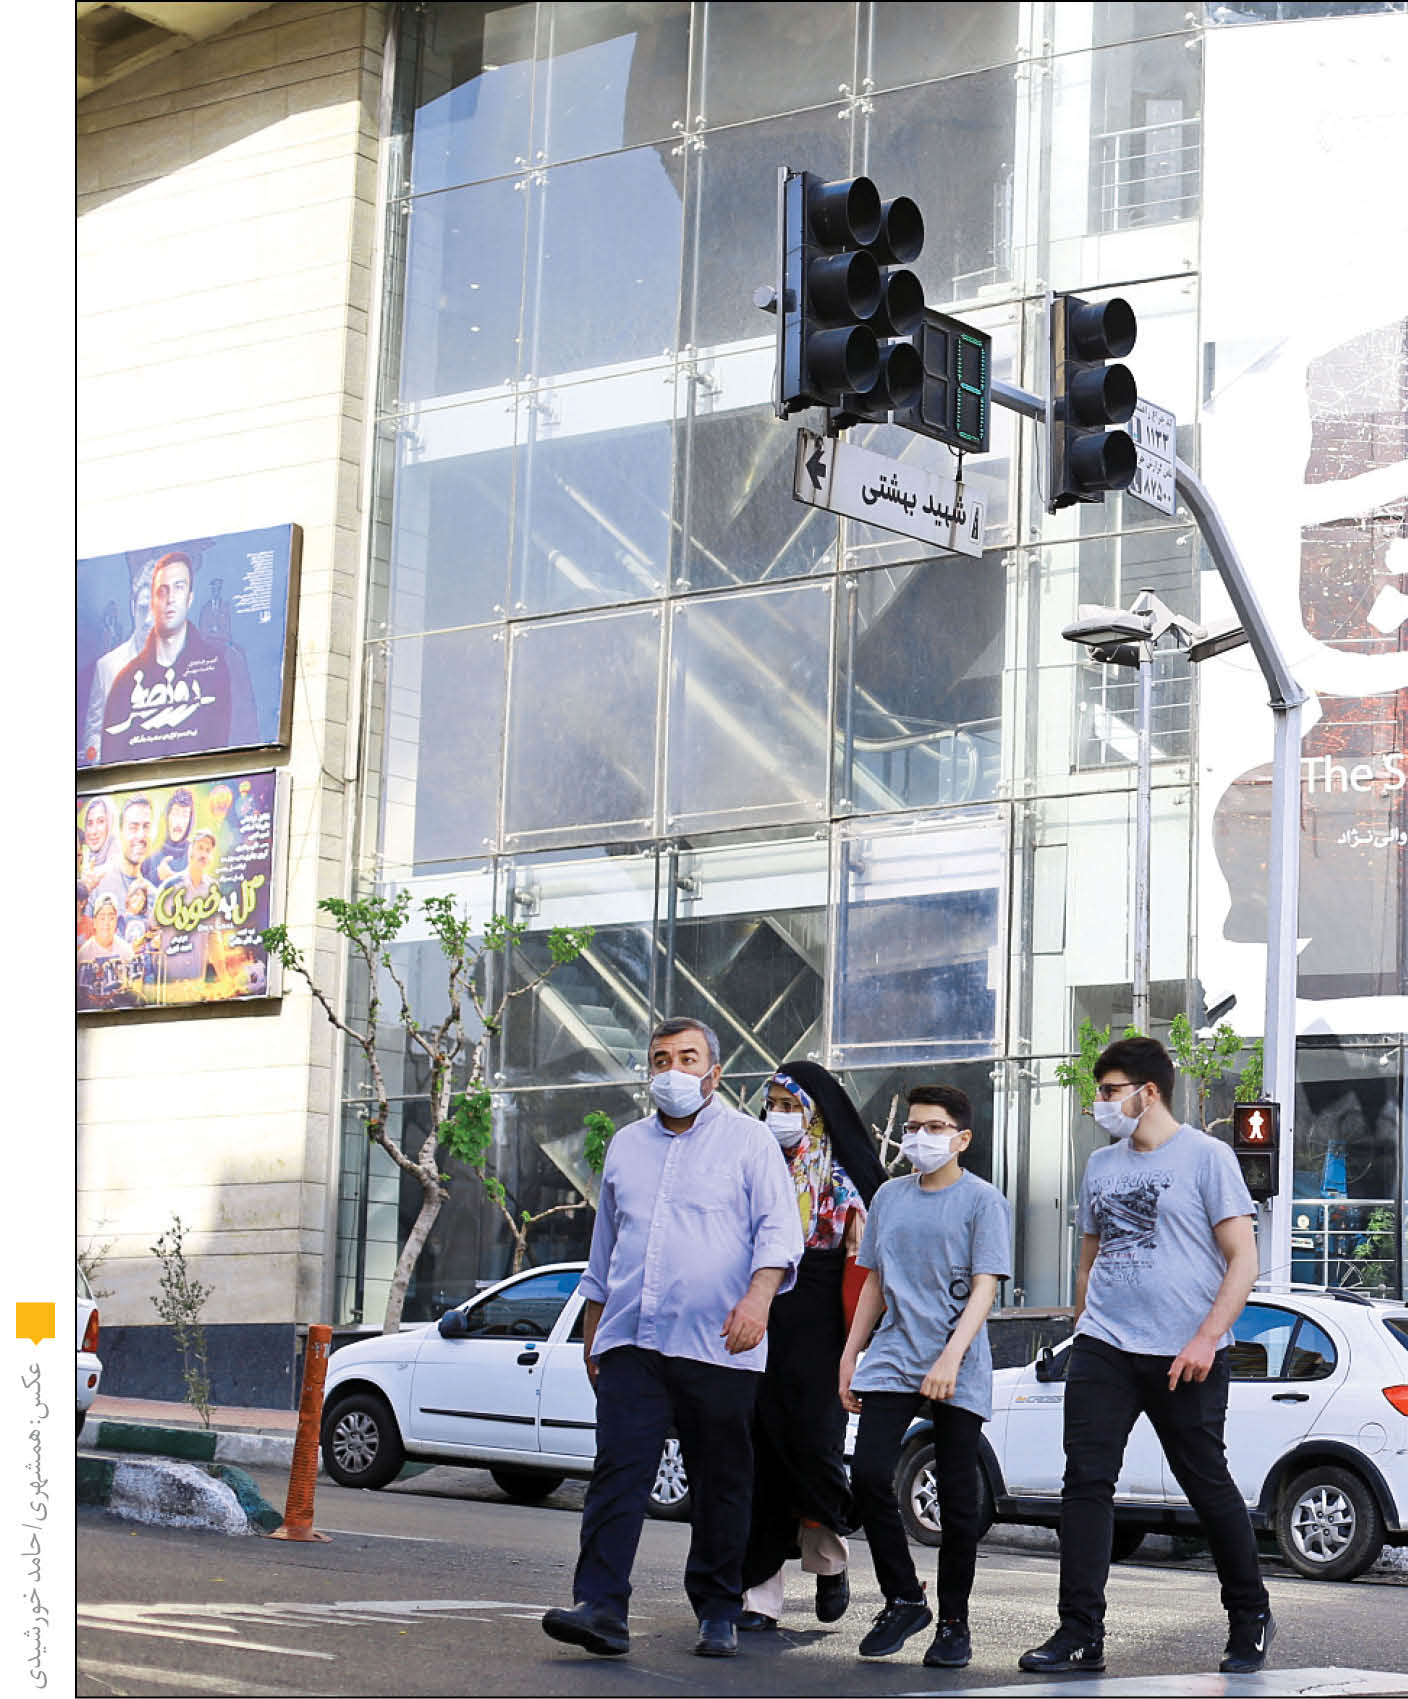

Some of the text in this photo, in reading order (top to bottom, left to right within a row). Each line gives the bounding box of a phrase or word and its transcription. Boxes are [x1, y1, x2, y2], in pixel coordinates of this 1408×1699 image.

[861, 473, 967, 528] شهید بهشتی
[1302, 757, 1374, 795] The
[154, 882, 222, 933] خودی
[231, 873, 266, 926] گل
